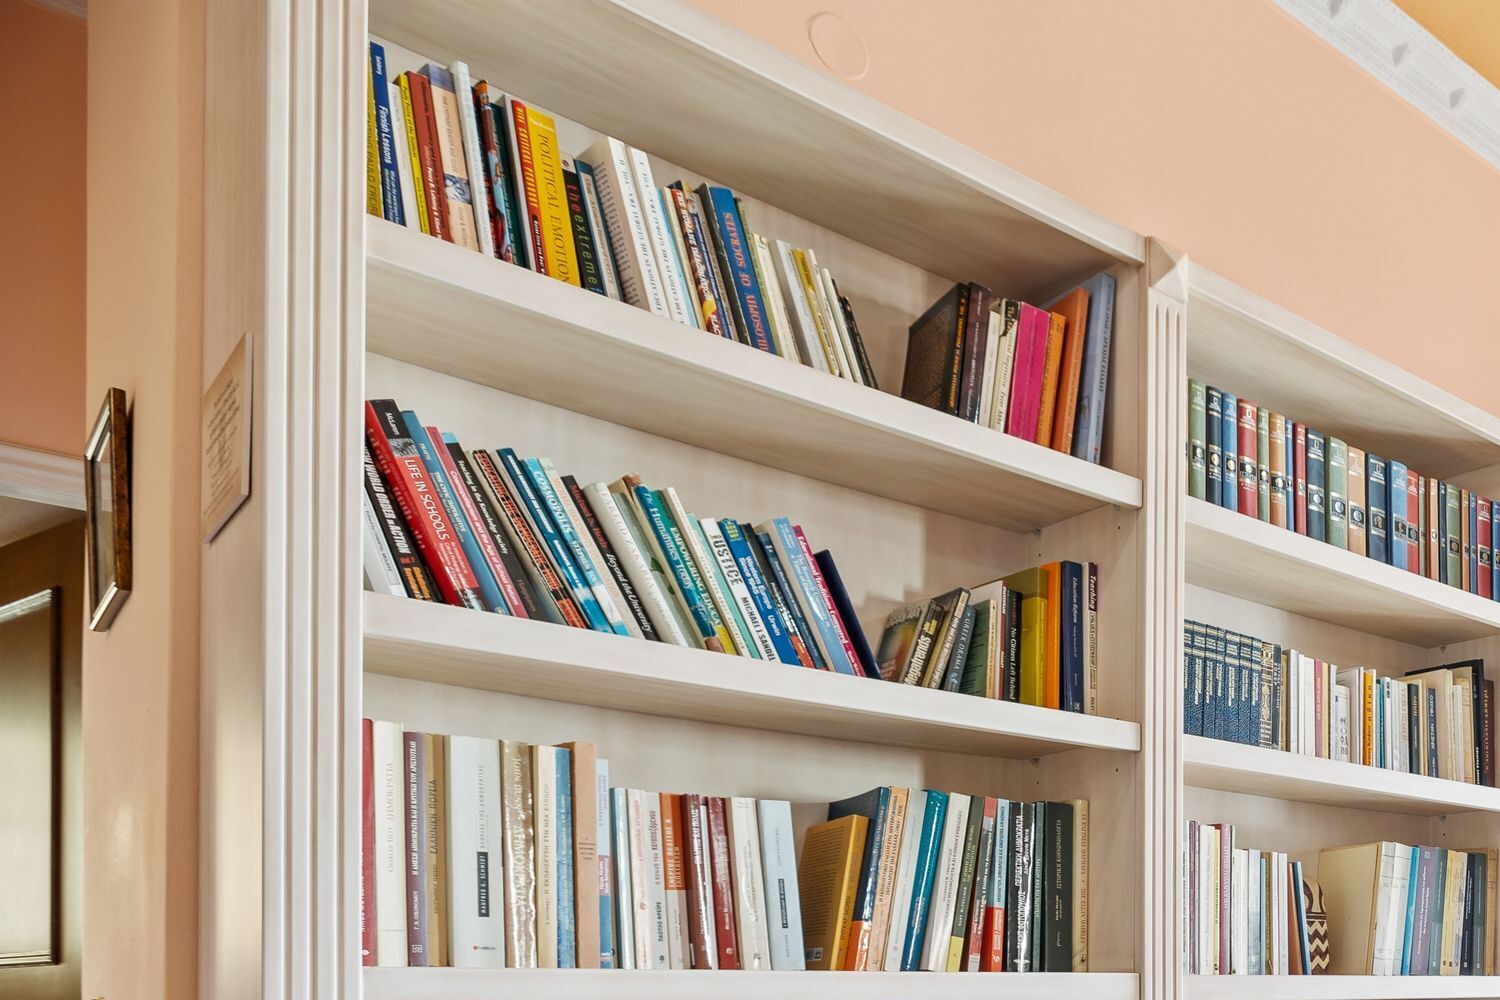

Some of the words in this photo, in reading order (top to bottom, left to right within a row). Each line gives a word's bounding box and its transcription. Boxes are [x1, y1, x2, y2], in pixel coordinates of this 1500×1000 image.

[379, 106, 390, 133] Finnish
[381, 133, 393, 163] Lessons
[538, 134, 559, 210] POLITICAL
[675, 191, 687, 206] THE
[680, 209, 697, 245] HUMANE
[689, 247, 712, 300] IMAGINATION
[385, 412, 400, 435] McLaren
[404, 459, 424, 479] LIFE
[457, 460, 477, 486] Teaching
[475, 452, 508, 497] EDUCATING
[413, 481, 430, 492] IN
[450, 470, 480, 520] Cosmopolitanism
[472, 492, 484, 502] the
[570, 485, 593, 517] Michael
[438, 483, 452, 500] CIVIC
[446, 501, 466, 533] IMPERATIVE
[506, 500, 526, 516] THE
[533, 471, 572, 533] COSMOPOLIS
[375, 493, 397, 519] ORDER
[388, 525, 410, 554] ACTION
[419, 495, 450, 541] SCHOOLS
[474, 522, 486, 533] and
[477, 503, 499, 533] Knowledge
[480, 535, 491, 544] the
[485, 545, 497, 556] Age
[491, 534, 509, 554] Society
[649, 507, 681, 560] Humanities
[671, 563, 693, 590] Today
[493, 564, 509, 583] School
[606, 554, 628, 581] Beyond
[709, 533, 743, 585] JUSTICE
[738, 558, 753, 578] Since
[619, 583, 634, 594] the
[745, 556, 762, 584] Western
[755, 585, 771, 609] Europe
[798, 536, 822, 576] Educational
[814, 577, 835, 609] Traditions
[827, 611, 849, 644] Compared
[624, 594, 652, 632] University
[767, 615, 780, 636] Urwin
[739, 597, 761, 626] MICHAEL
[755, 634, 776, 661] SANDEL
[959, 618, 971, 642] GREEK
[1010, 628, 1017, 638] No
[953, 643, 966, 670] DRAMA
[430, 780, 438, 809] ΠΟΡΕΙΑ
[513, 783, 521, 810] DUNN
[430, 813, 438, 854] ΕΛΛΗΝΙΚΗ
[513, 825, 525, 906] ΔΗΜΟΚΡΑΤΙΑ
[1015, 852, 1023, 886] ΠΕΡΙΕΚΤΙΚΗ
